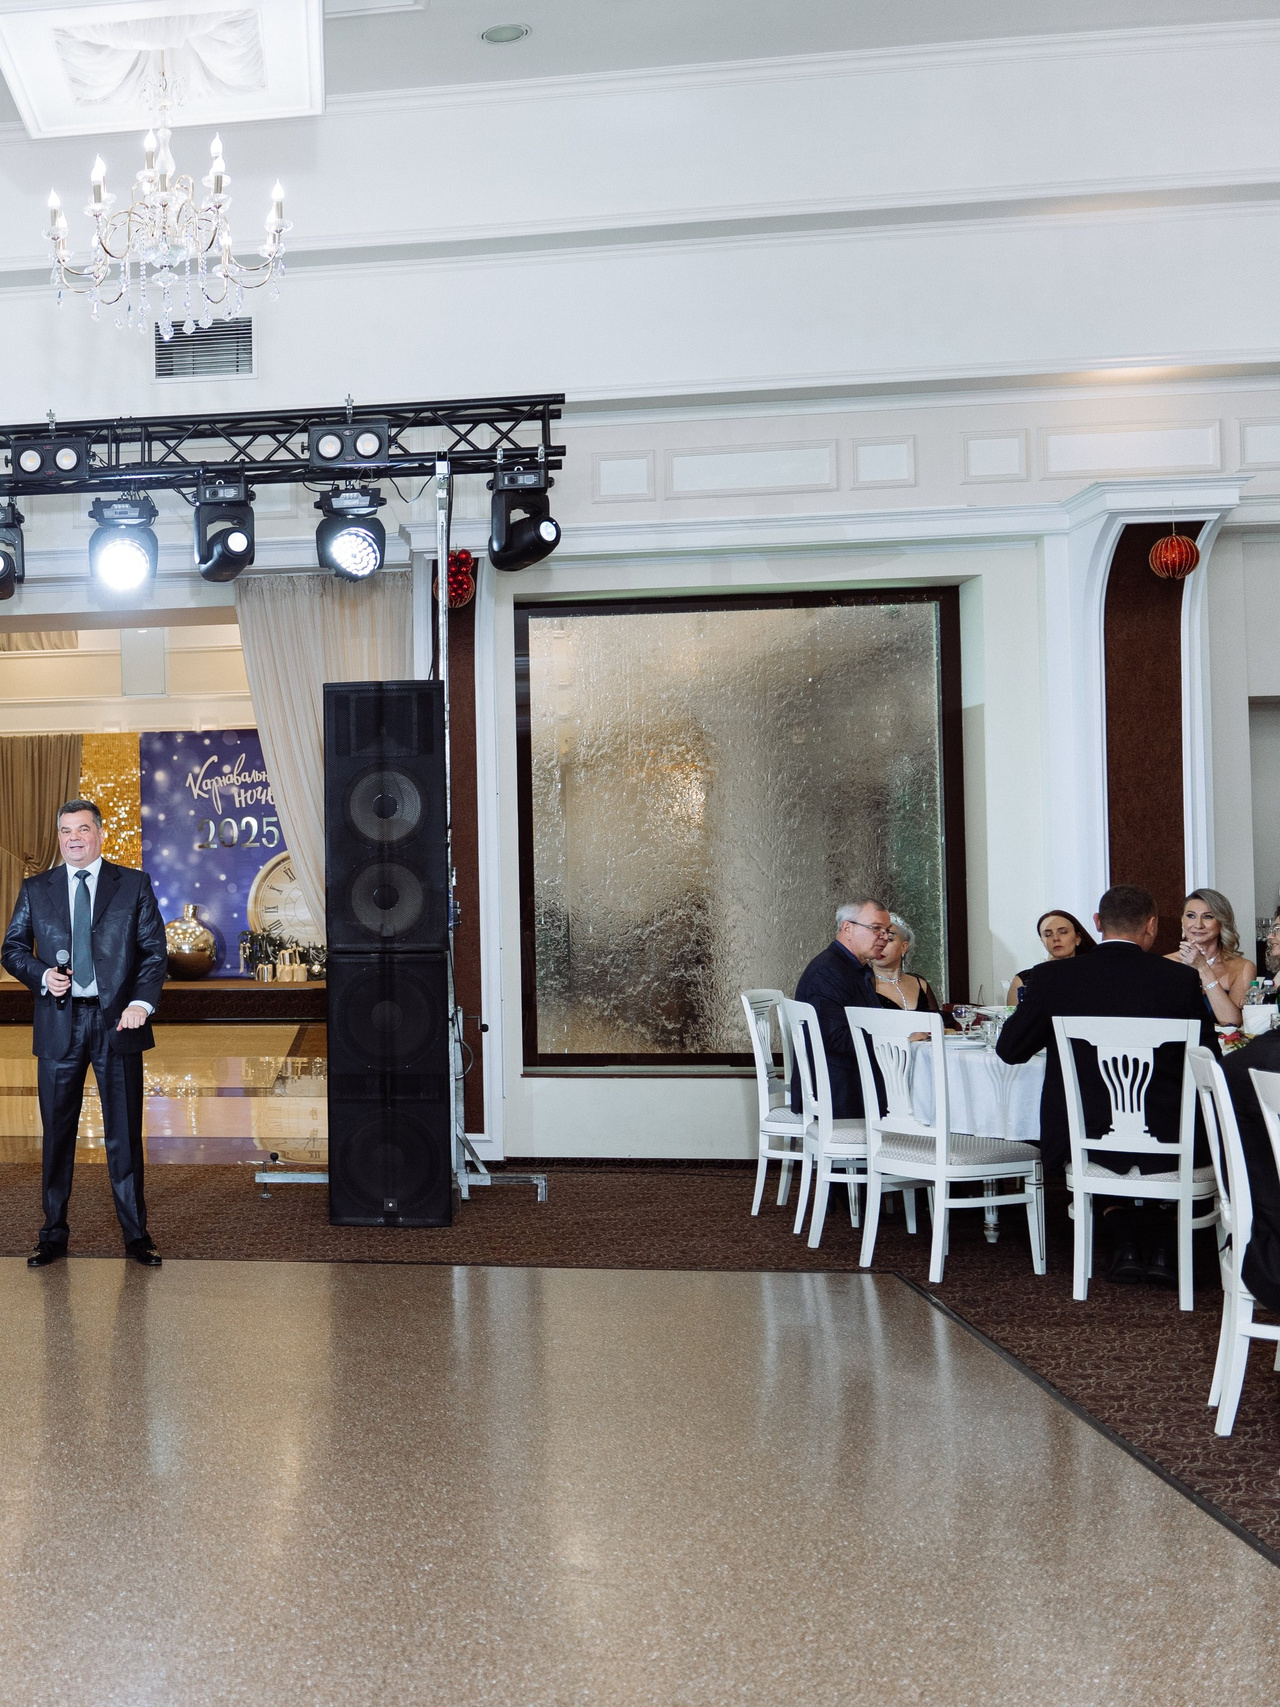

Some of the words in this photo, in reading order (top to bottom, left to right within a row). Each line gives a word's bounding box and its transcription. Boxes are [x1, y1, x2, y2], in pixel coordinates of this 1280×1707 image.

[185, 753, 269, 815] Карнавальн
[198, 816, 280, 848] 2025
[264, 905, 278, 913] IX
